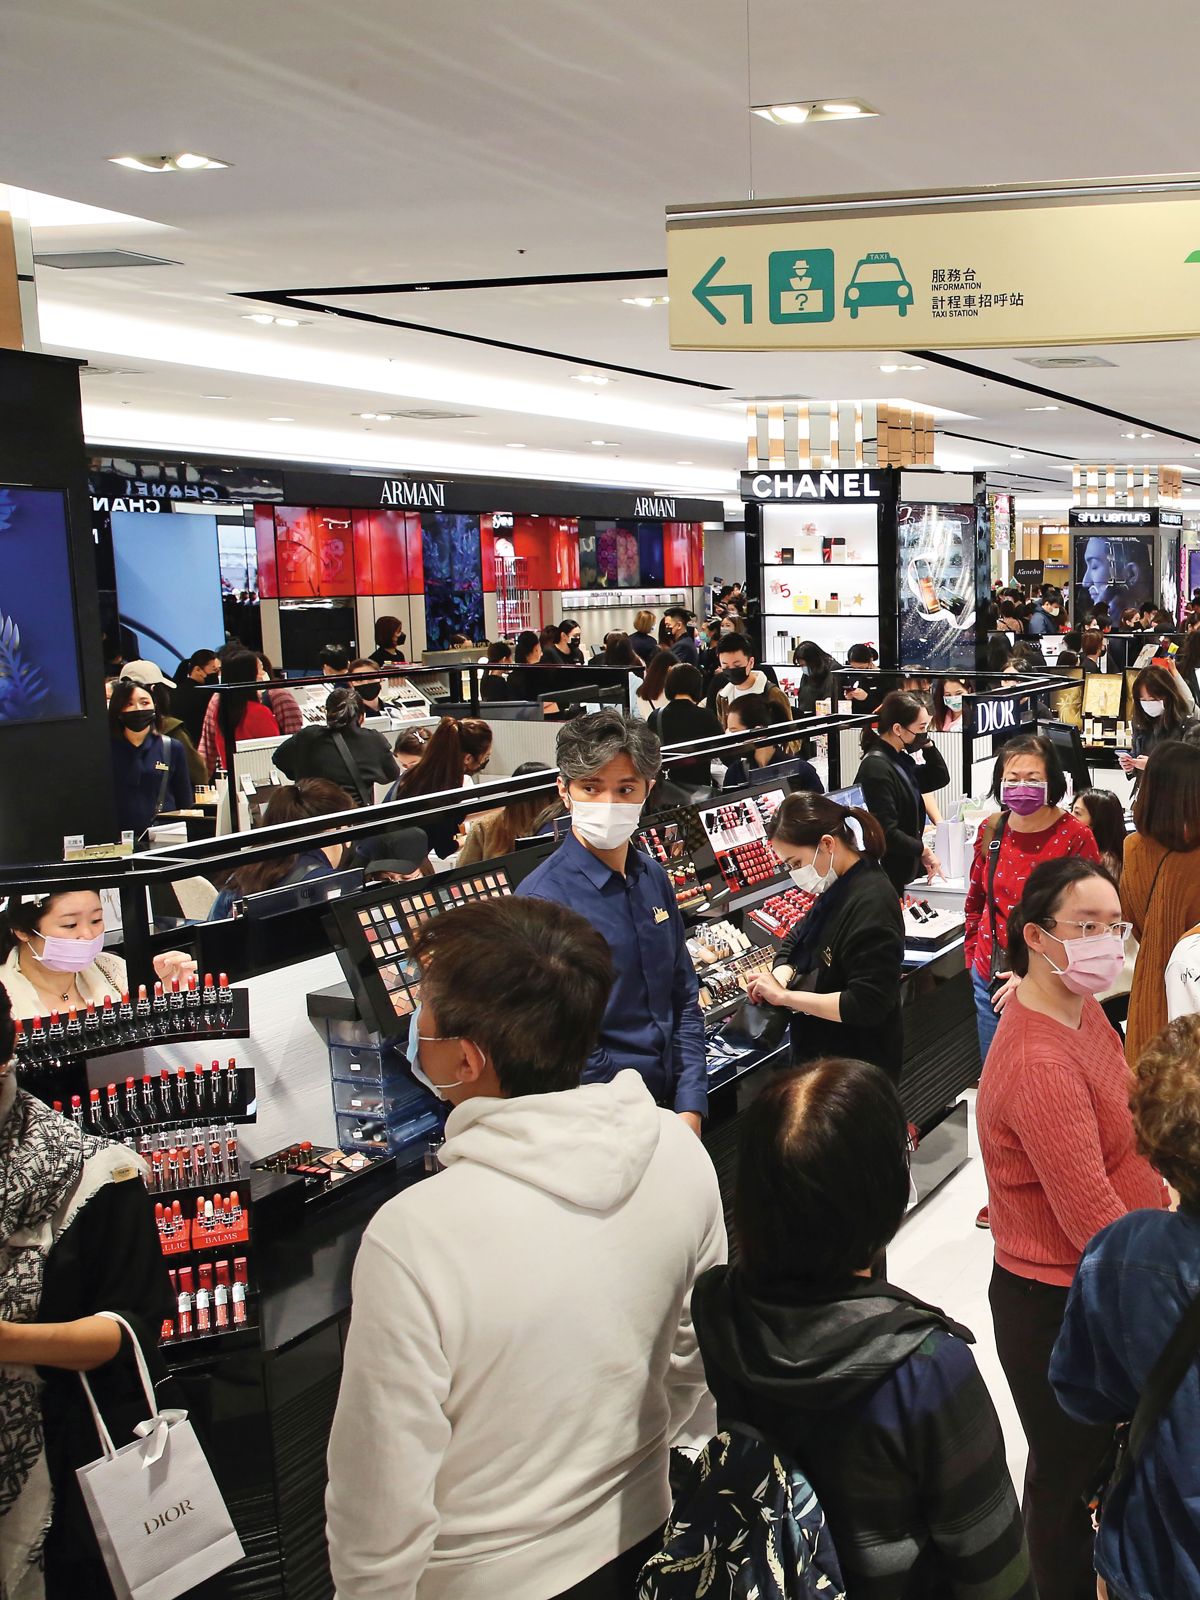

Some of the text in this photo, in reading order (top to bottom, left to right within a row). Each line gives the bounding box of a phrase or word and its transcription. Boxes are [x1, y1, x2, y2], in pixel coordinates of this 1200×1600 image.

[869, 253, 888, 261] TAXI
[931, 268, 977, 283] 服務台
[931, 282, 982, 292] INFORMATION
[931, 292, 1024, 310] 計程車招呼站
[931, 309, 979, 318] TAXI STATION
[752, 473, 880, 498] CHANEL
[380, 481, 446, 507] ARMANI
[634, 497, 676, 518] ARMANI
[1077, 512, 1100, 523] shu
[1102, 512, 1151, 523] uemura
[1016, 567, 1042, 575] Kanebo
[976, 699, 1016, 734] DIOR
[205, 1232, 238, 1244] BALMS
[162, 1242, 187, 1252] LLIC
[144, 1499, 195, 1535] DIOR
